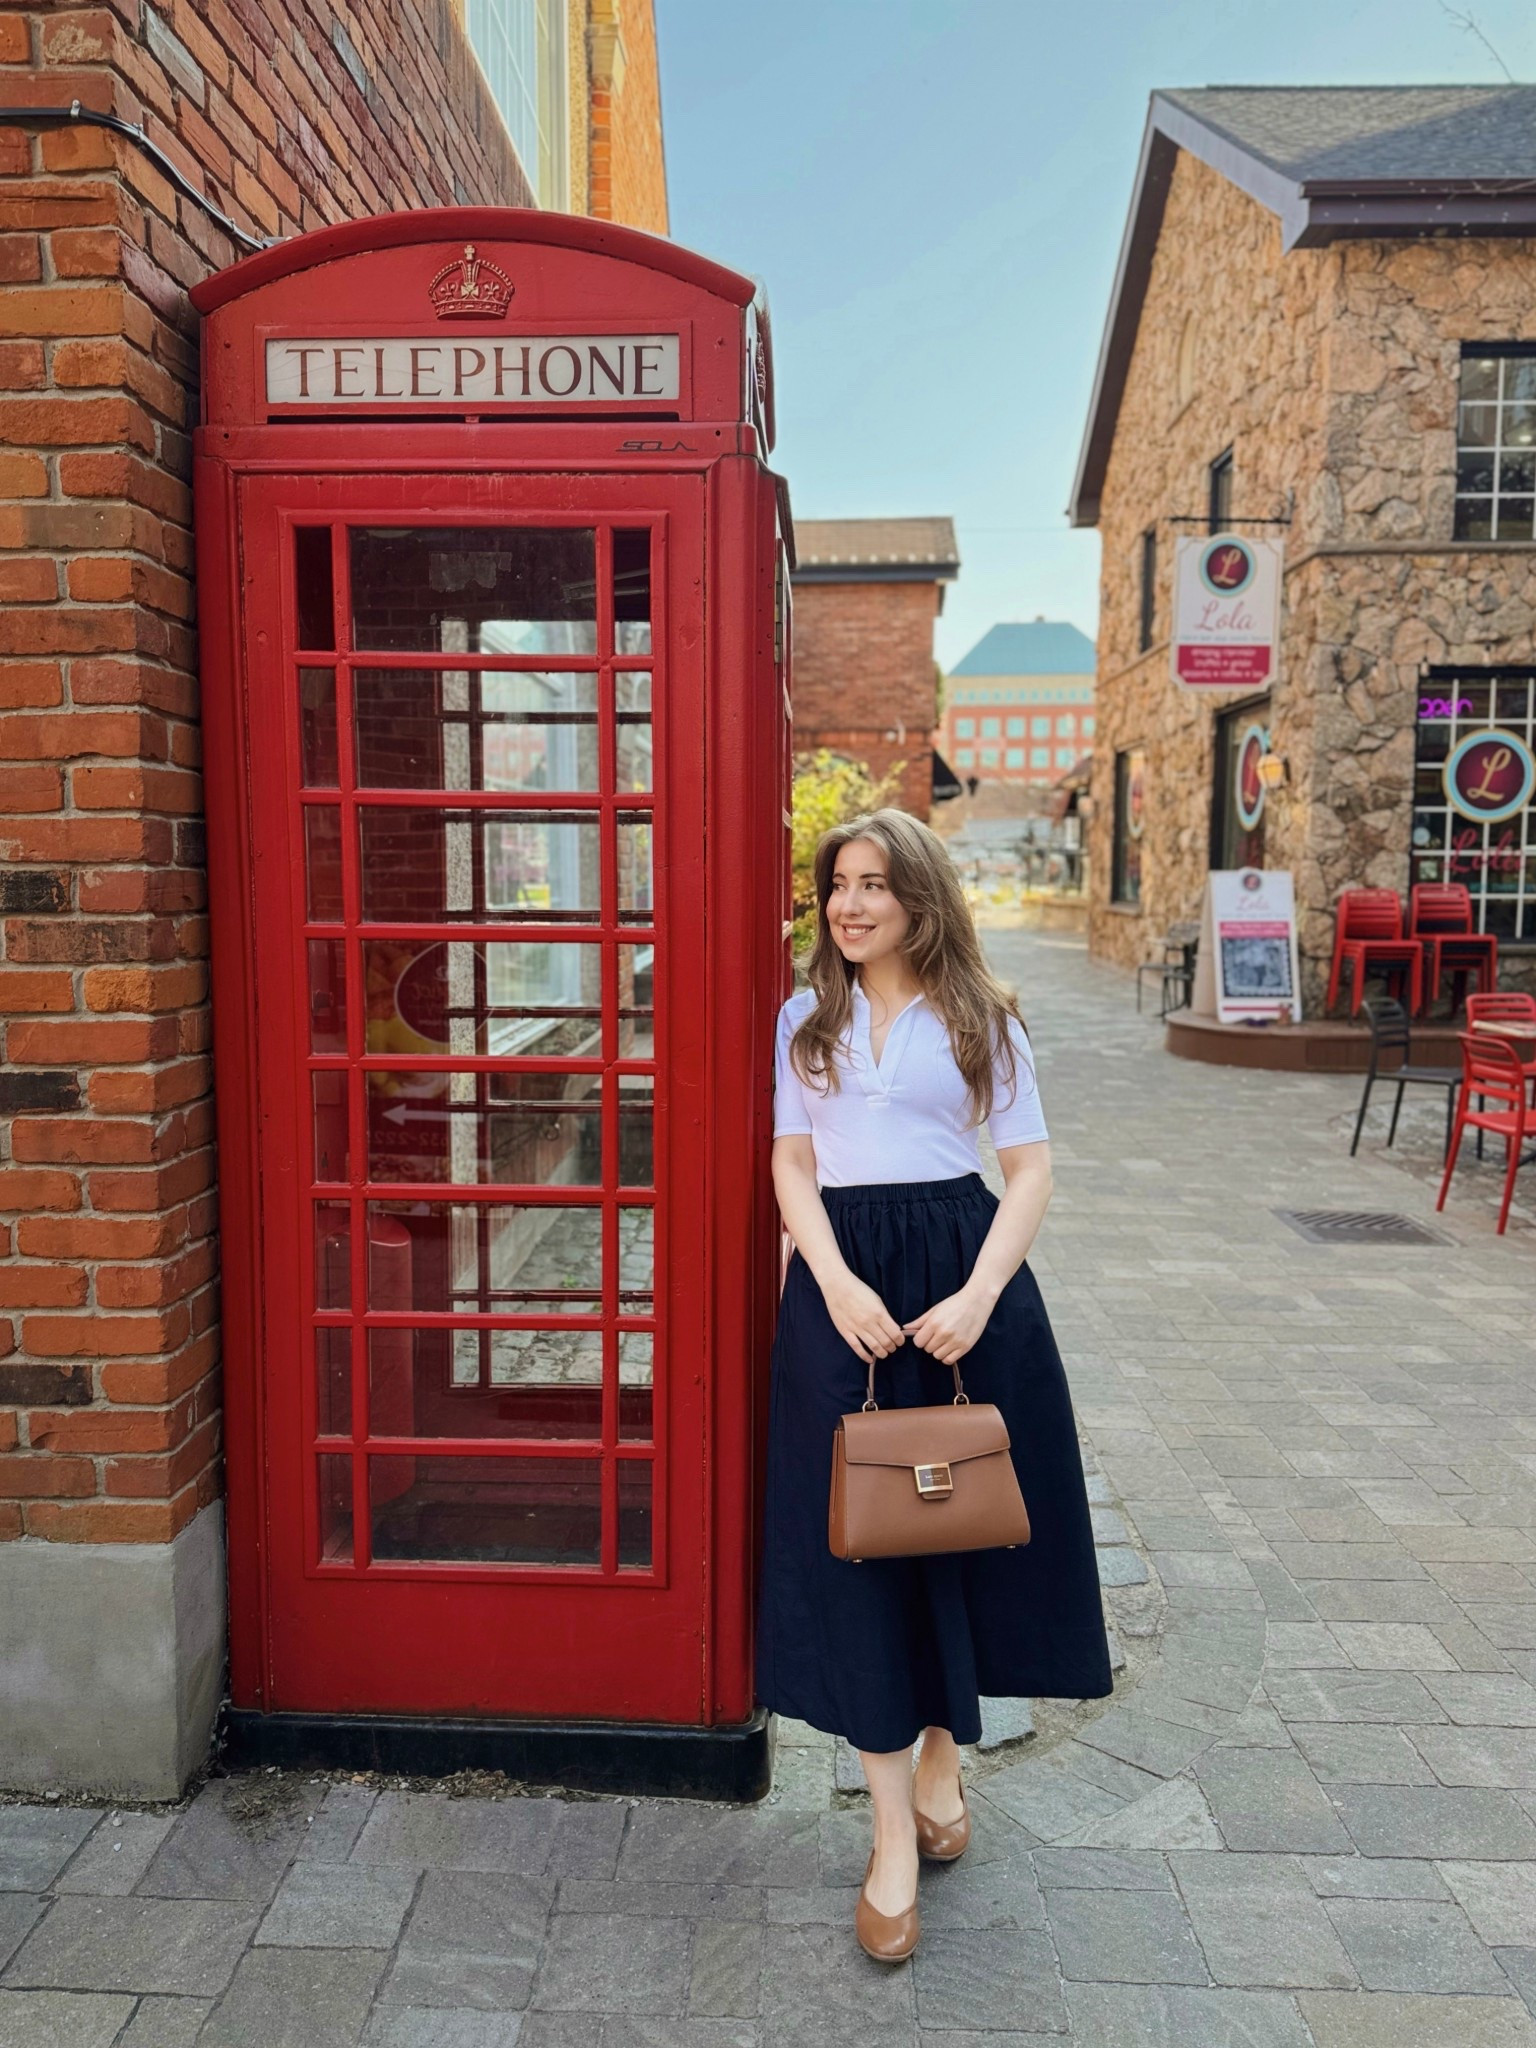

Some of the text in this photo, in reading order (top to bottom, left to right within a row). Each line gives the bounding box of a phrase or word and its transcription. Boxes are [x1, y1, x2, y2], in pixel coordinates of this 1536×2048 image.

[285, 345, 664, 397] TELEPHONE
[1212, 548, 1242, 585] L
[1194, 599, 1256, 632] Lola
[1466, 747, 1512, 801] L
[1443, 827, 1525, 873] Lola
